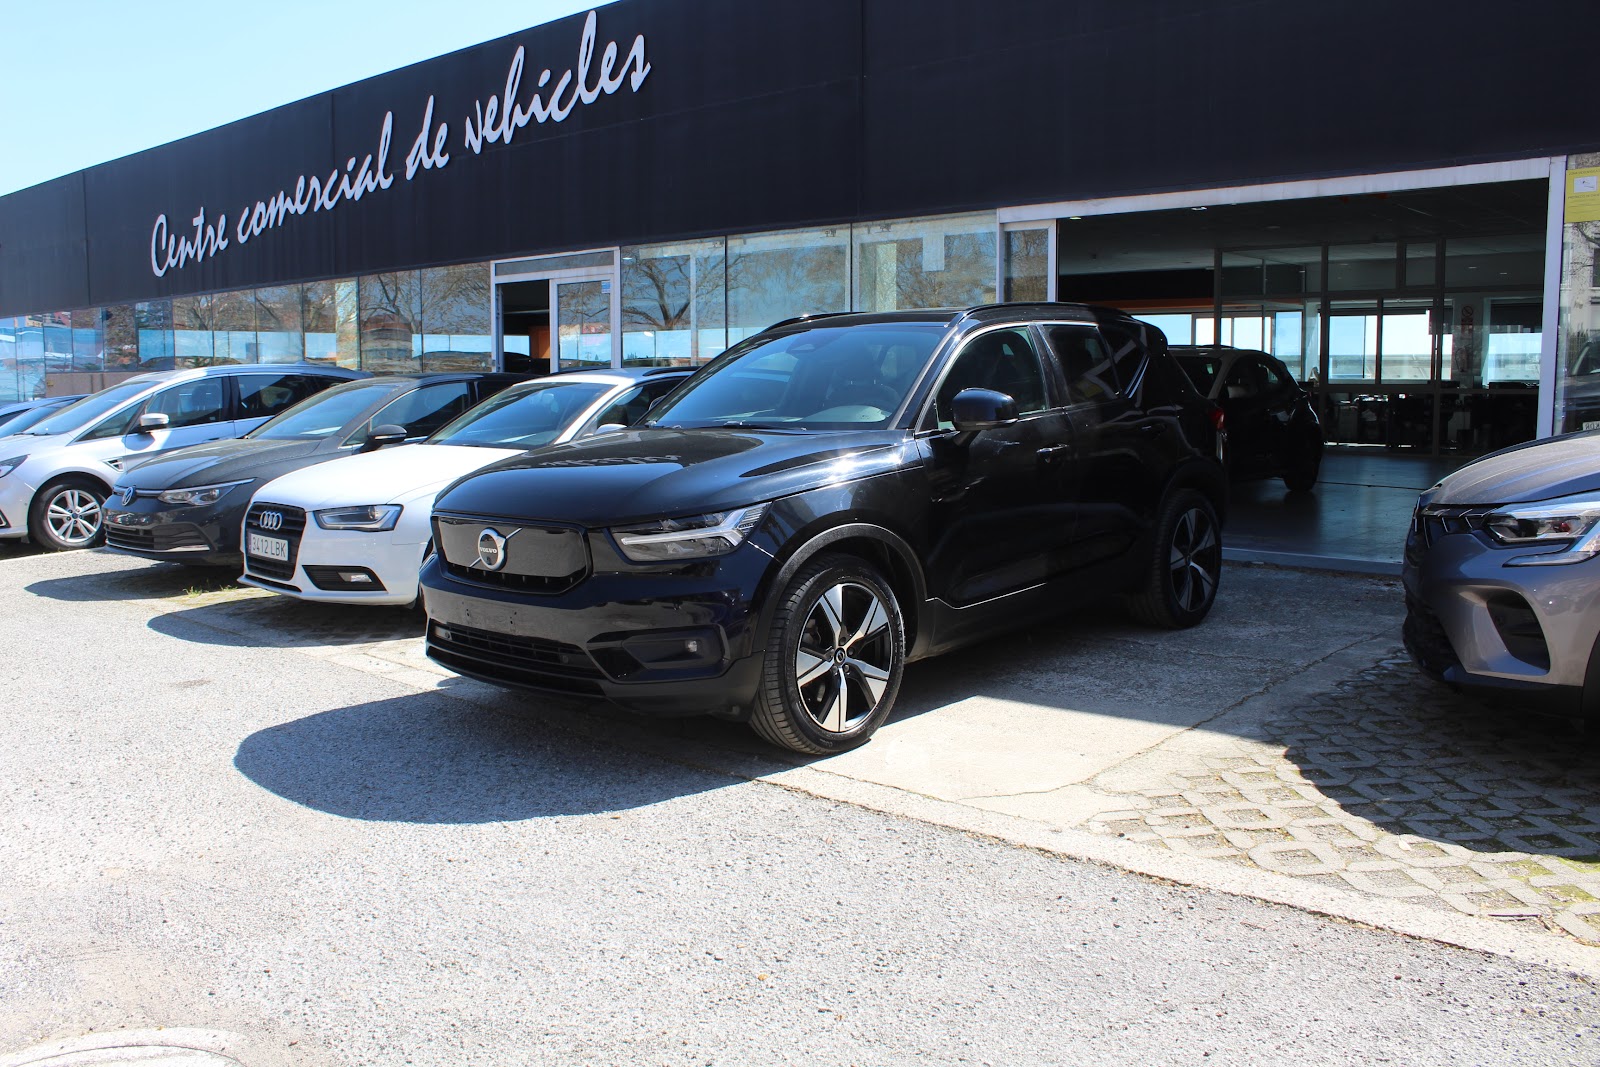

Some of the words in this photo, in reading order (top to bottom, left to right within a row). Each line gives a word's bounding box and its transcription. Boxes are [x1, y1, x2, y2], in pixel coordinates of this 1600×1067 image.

[151, 206, 229, 278] Centre
[237, 111, 394, 244] comercial
[405, 95, 450, 181] de
[465, 11, 652, 155] vehicles
[252, 536, 269, 554] 3412
[270, 540, 286, 558] LBK
